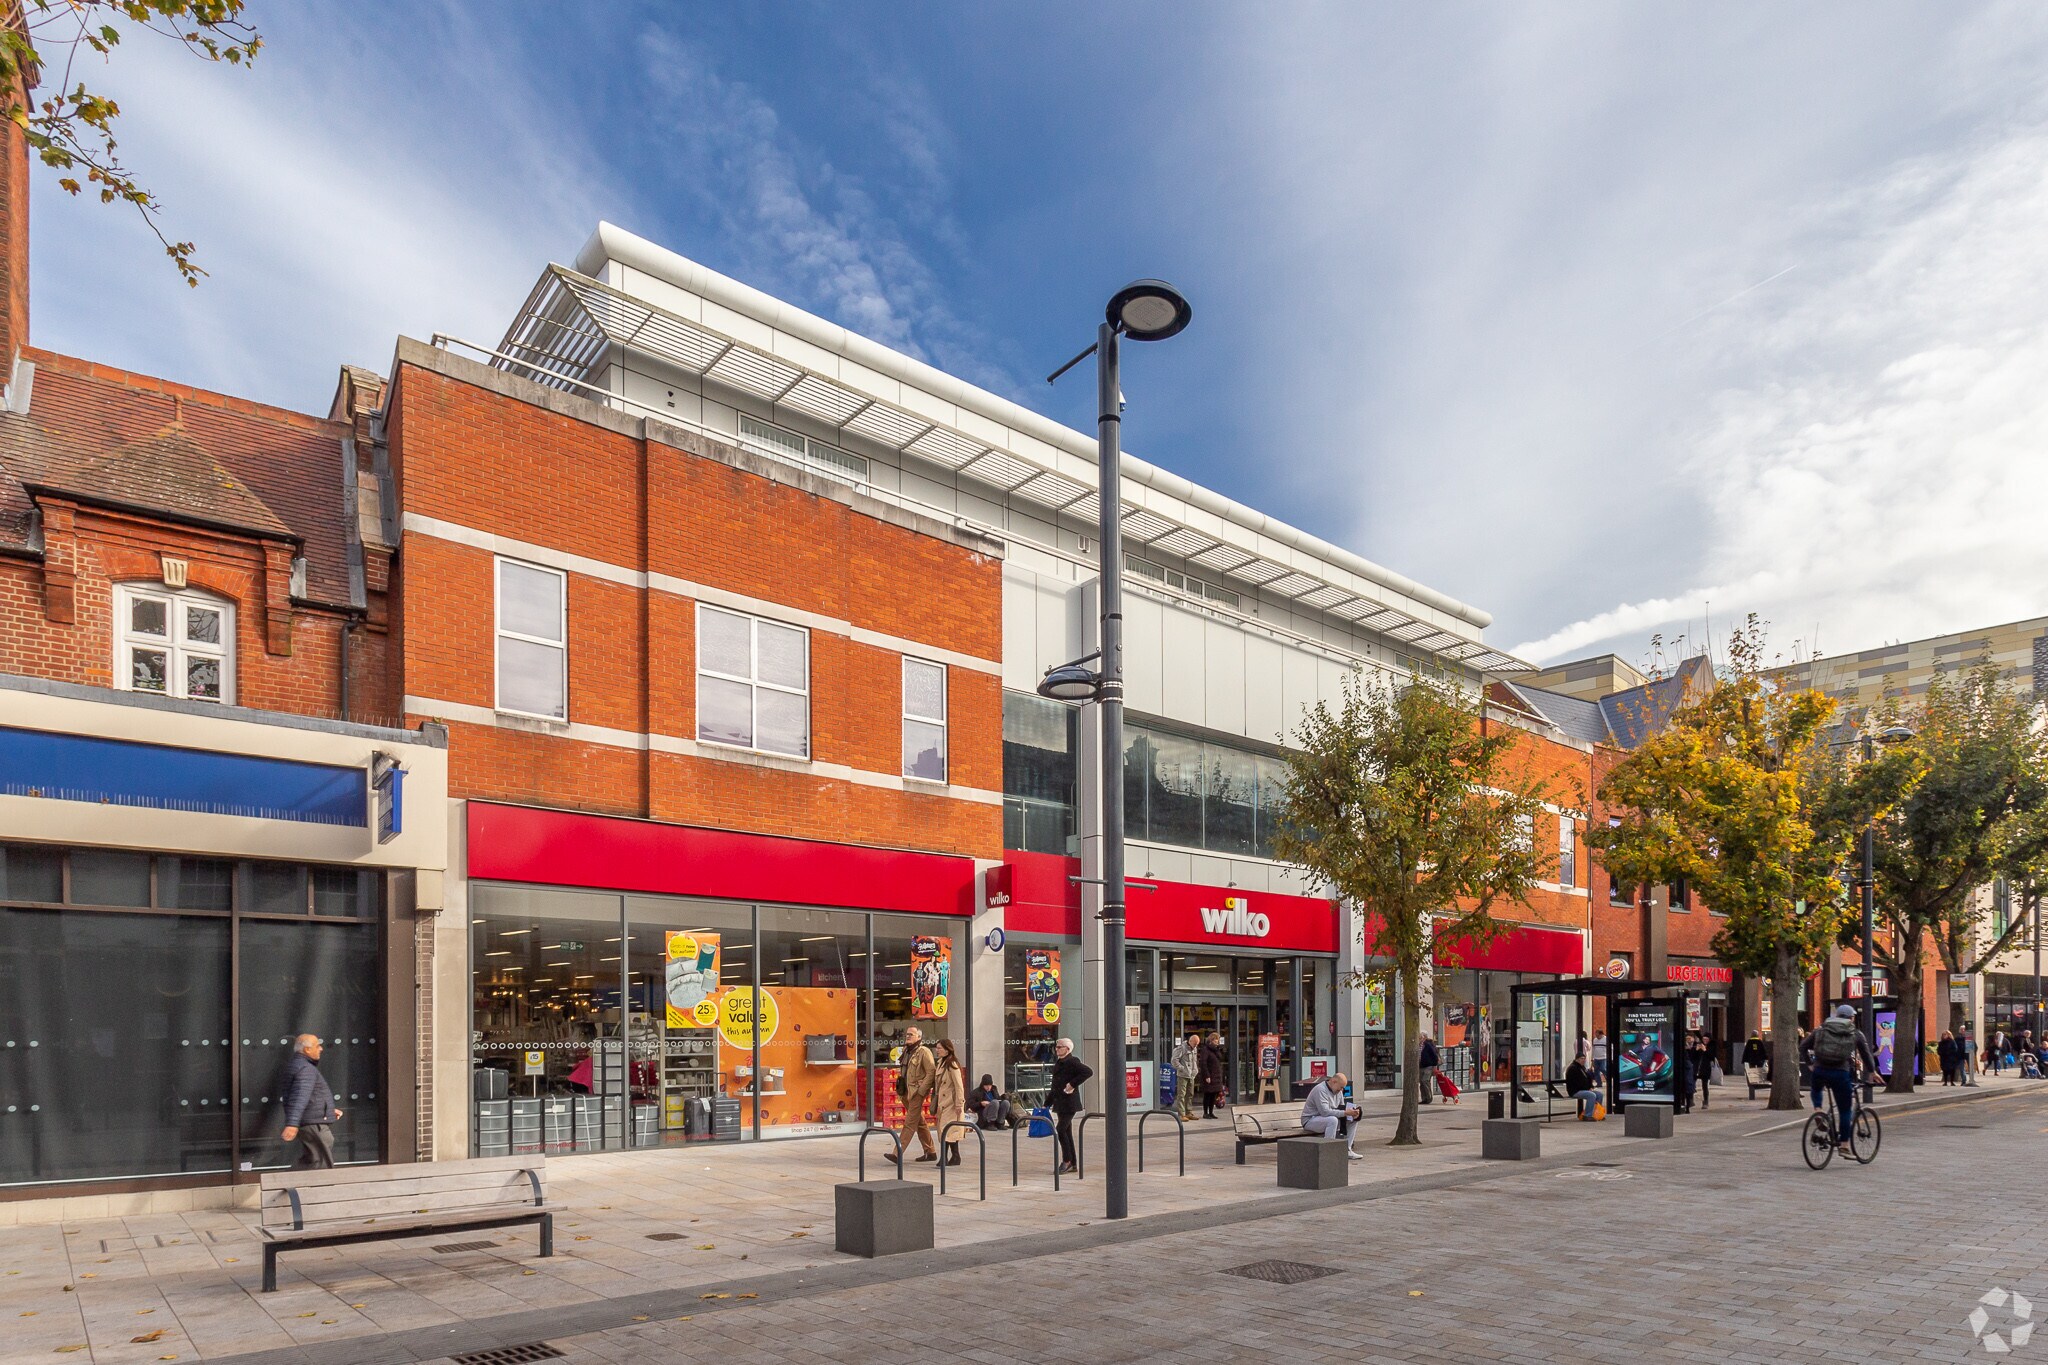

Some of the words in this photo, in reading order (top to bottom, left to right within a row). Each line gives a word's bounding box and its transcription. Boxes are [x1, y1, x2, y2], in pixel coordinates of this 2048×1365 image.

[990, 892, 1010, 906] wilko
[1200, 897, 1270, 938] wilko
[1667, 965, 1703, 981] URGER
[1706, 967, 1733, 983] KING
[729, 996, 766, 1012] gret
[727, 1027, 740, 1036] this
